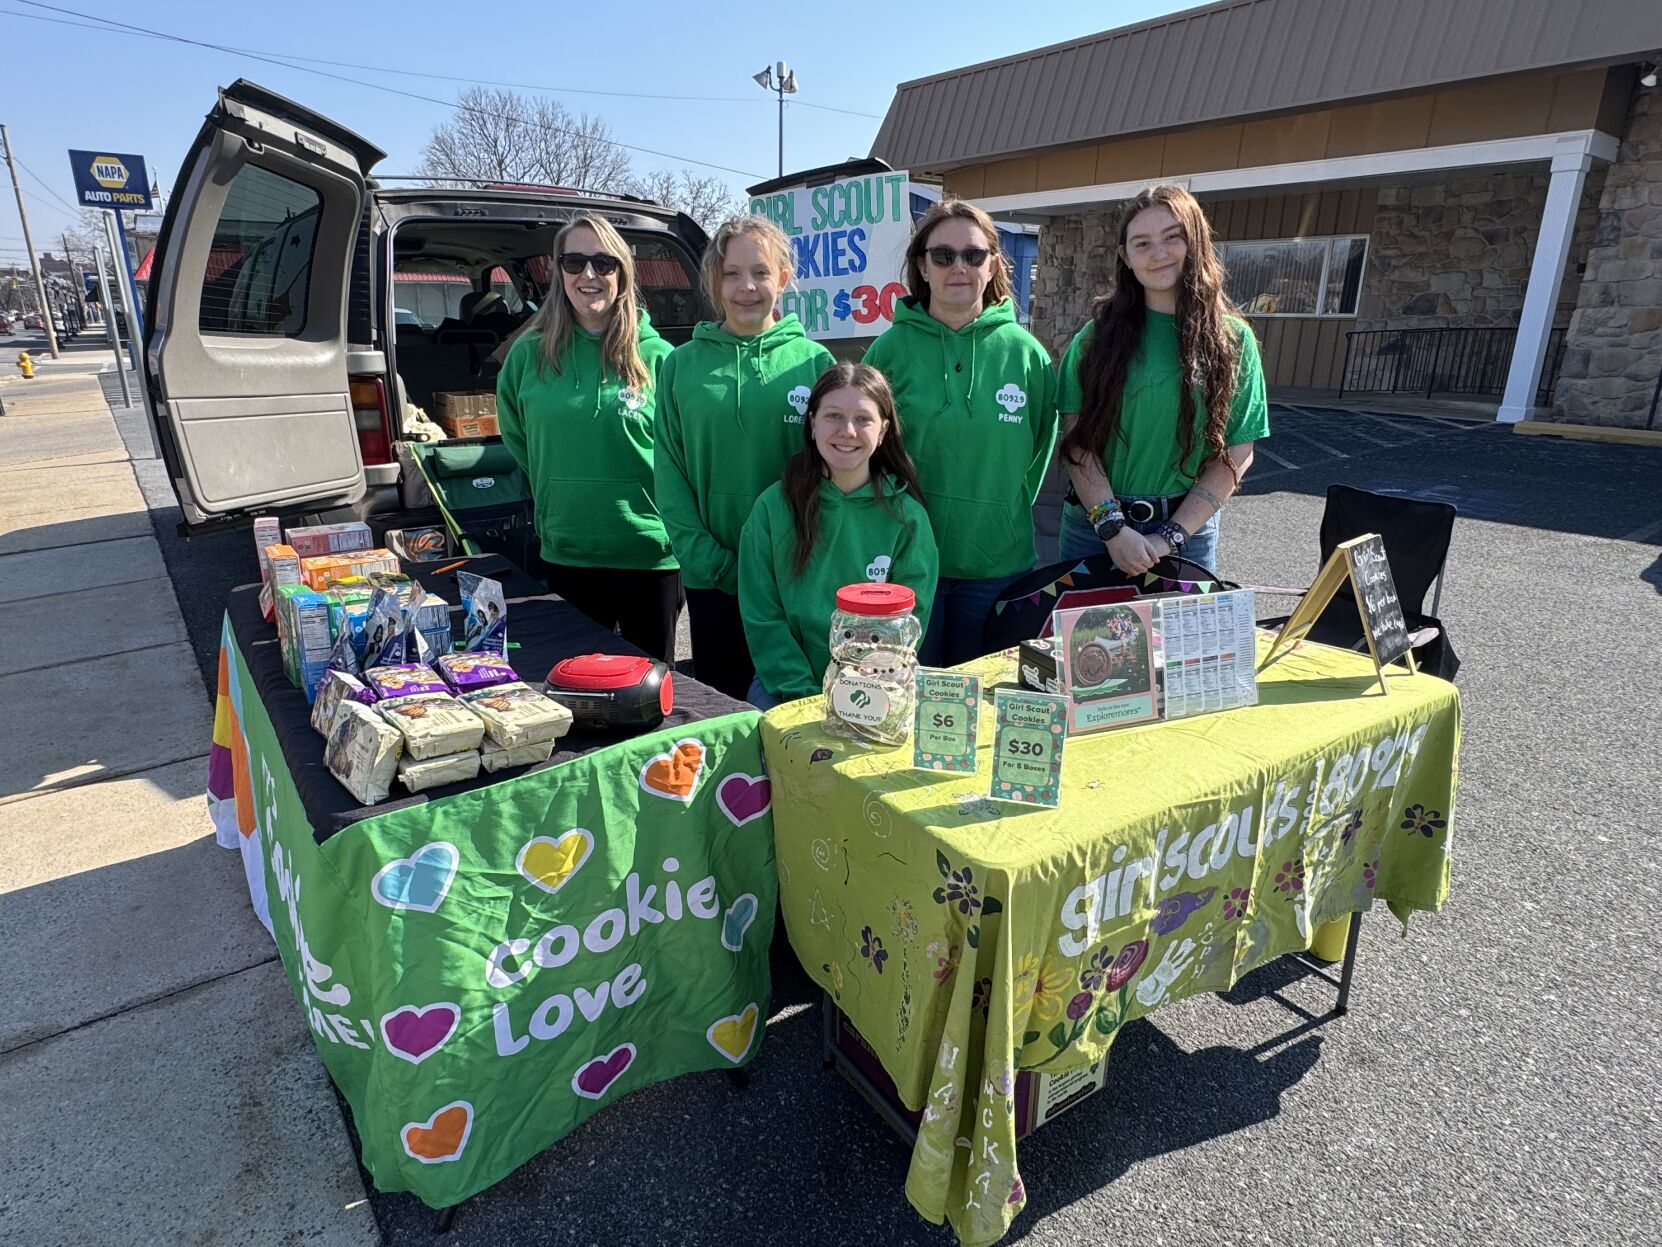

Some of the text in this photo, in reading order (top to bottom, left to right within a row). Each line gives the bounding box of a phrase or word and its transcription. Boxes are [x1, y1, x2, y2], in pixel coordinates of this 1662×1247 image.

[96, 164, 125, 180] NAPA
[85, 191, 146, 204] AUTO PARTS
[811, 174, 906, 231] SCOUT
[791, 227, 867, 280] OKIES
[783, 281, 909, 332] FOR $30
[789, 394, 809, 405] 809
[998, 393, 1025, 404] 80929
[998, 413, 1023, 424] PENNY
[868, 567, 889, 576] 809
[840, 678, 881, 690] DONATIONS
[941, 680, 964, 688] Scout
[929, 689, 960, 698] Cookies
[1009, 703, 1050, 714] Girl Scout
[838, 710, 862, 720] THANK
[933, 713, 954, 728] $6
[1012, 714, 1045, 724] Cookies
[1008, 738, 1044, 756] $30
[1003, 760, 1015, 768] For
[1024, 764, 1046, 772] Boxes
[492, 963, 647, 1057] Love
